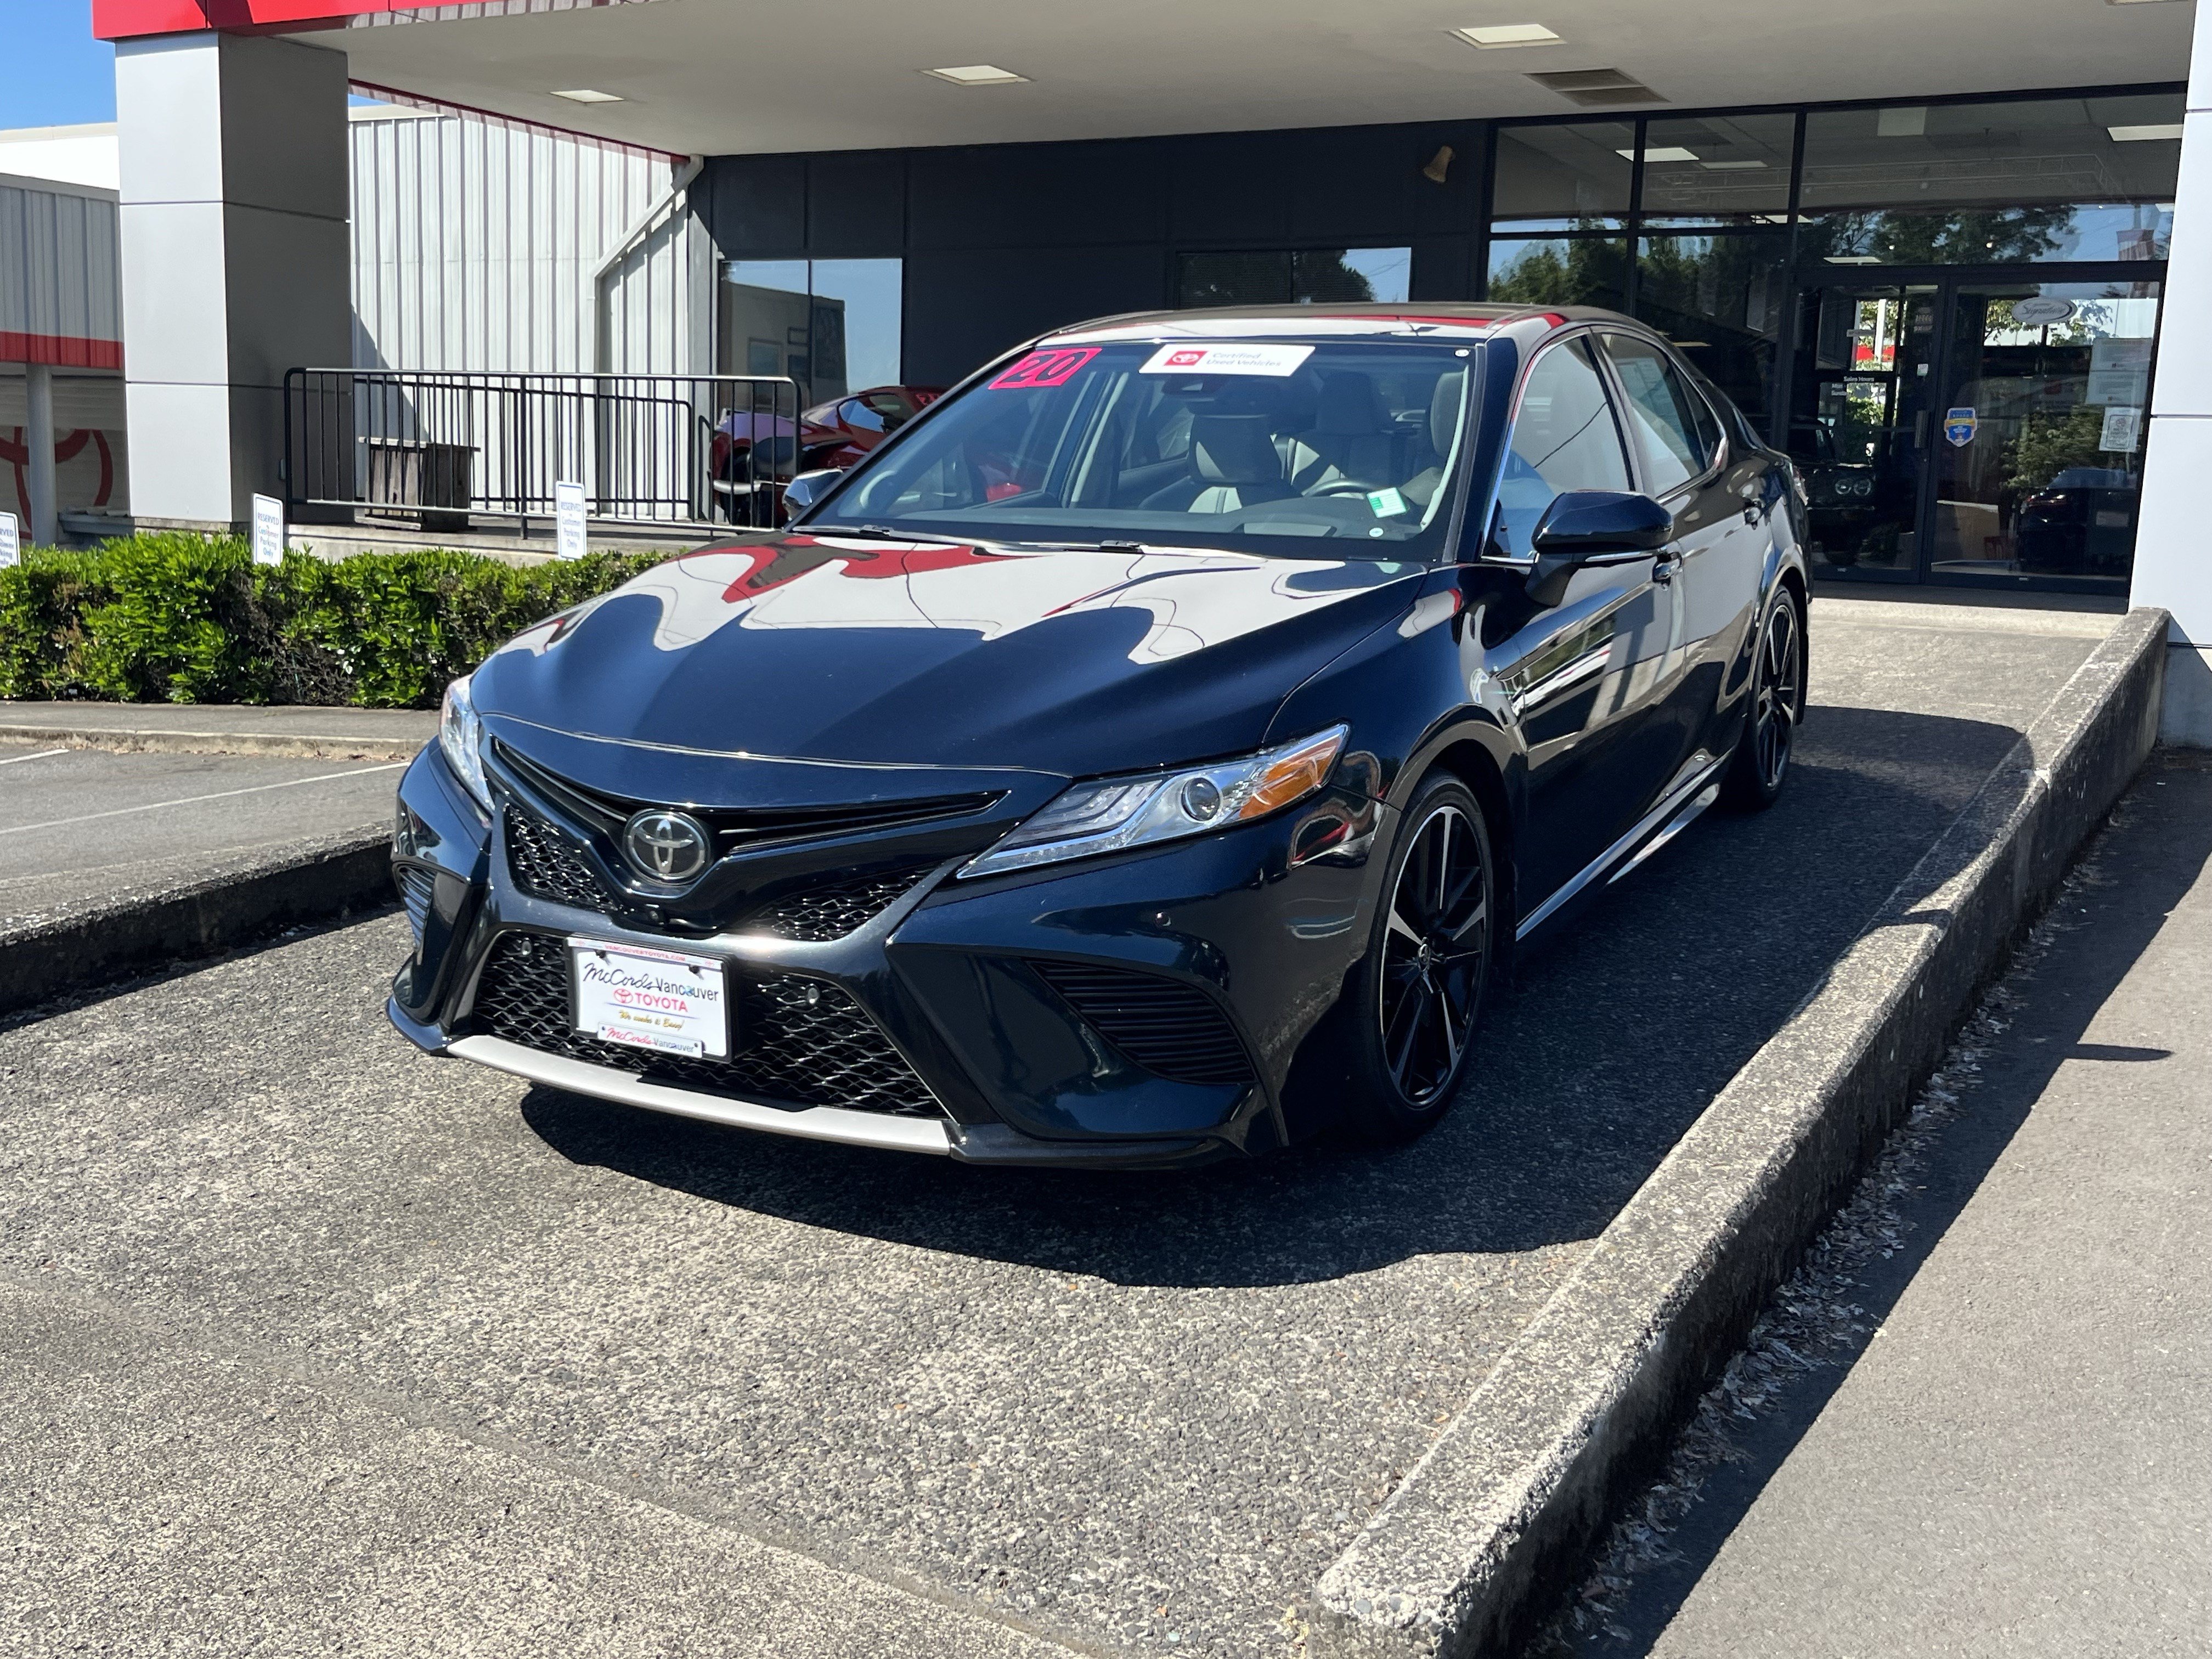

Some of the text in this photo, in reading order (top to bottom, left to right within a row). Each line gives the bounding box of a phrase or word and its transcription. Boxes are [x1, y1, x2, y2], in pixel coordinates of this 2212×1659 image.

[996, 351, 1088, 385] 20
[257, 512, 279, 525] RESERVED
[258, 526, 279, 538] Customer
[261, 536, 277, 551] Parking
[263, 547, 274, 559] Only
[605, 945, 686, 961] VANCOUVERTOYOTA.COM
[635, 992, 688, 1013] TOYOTA
